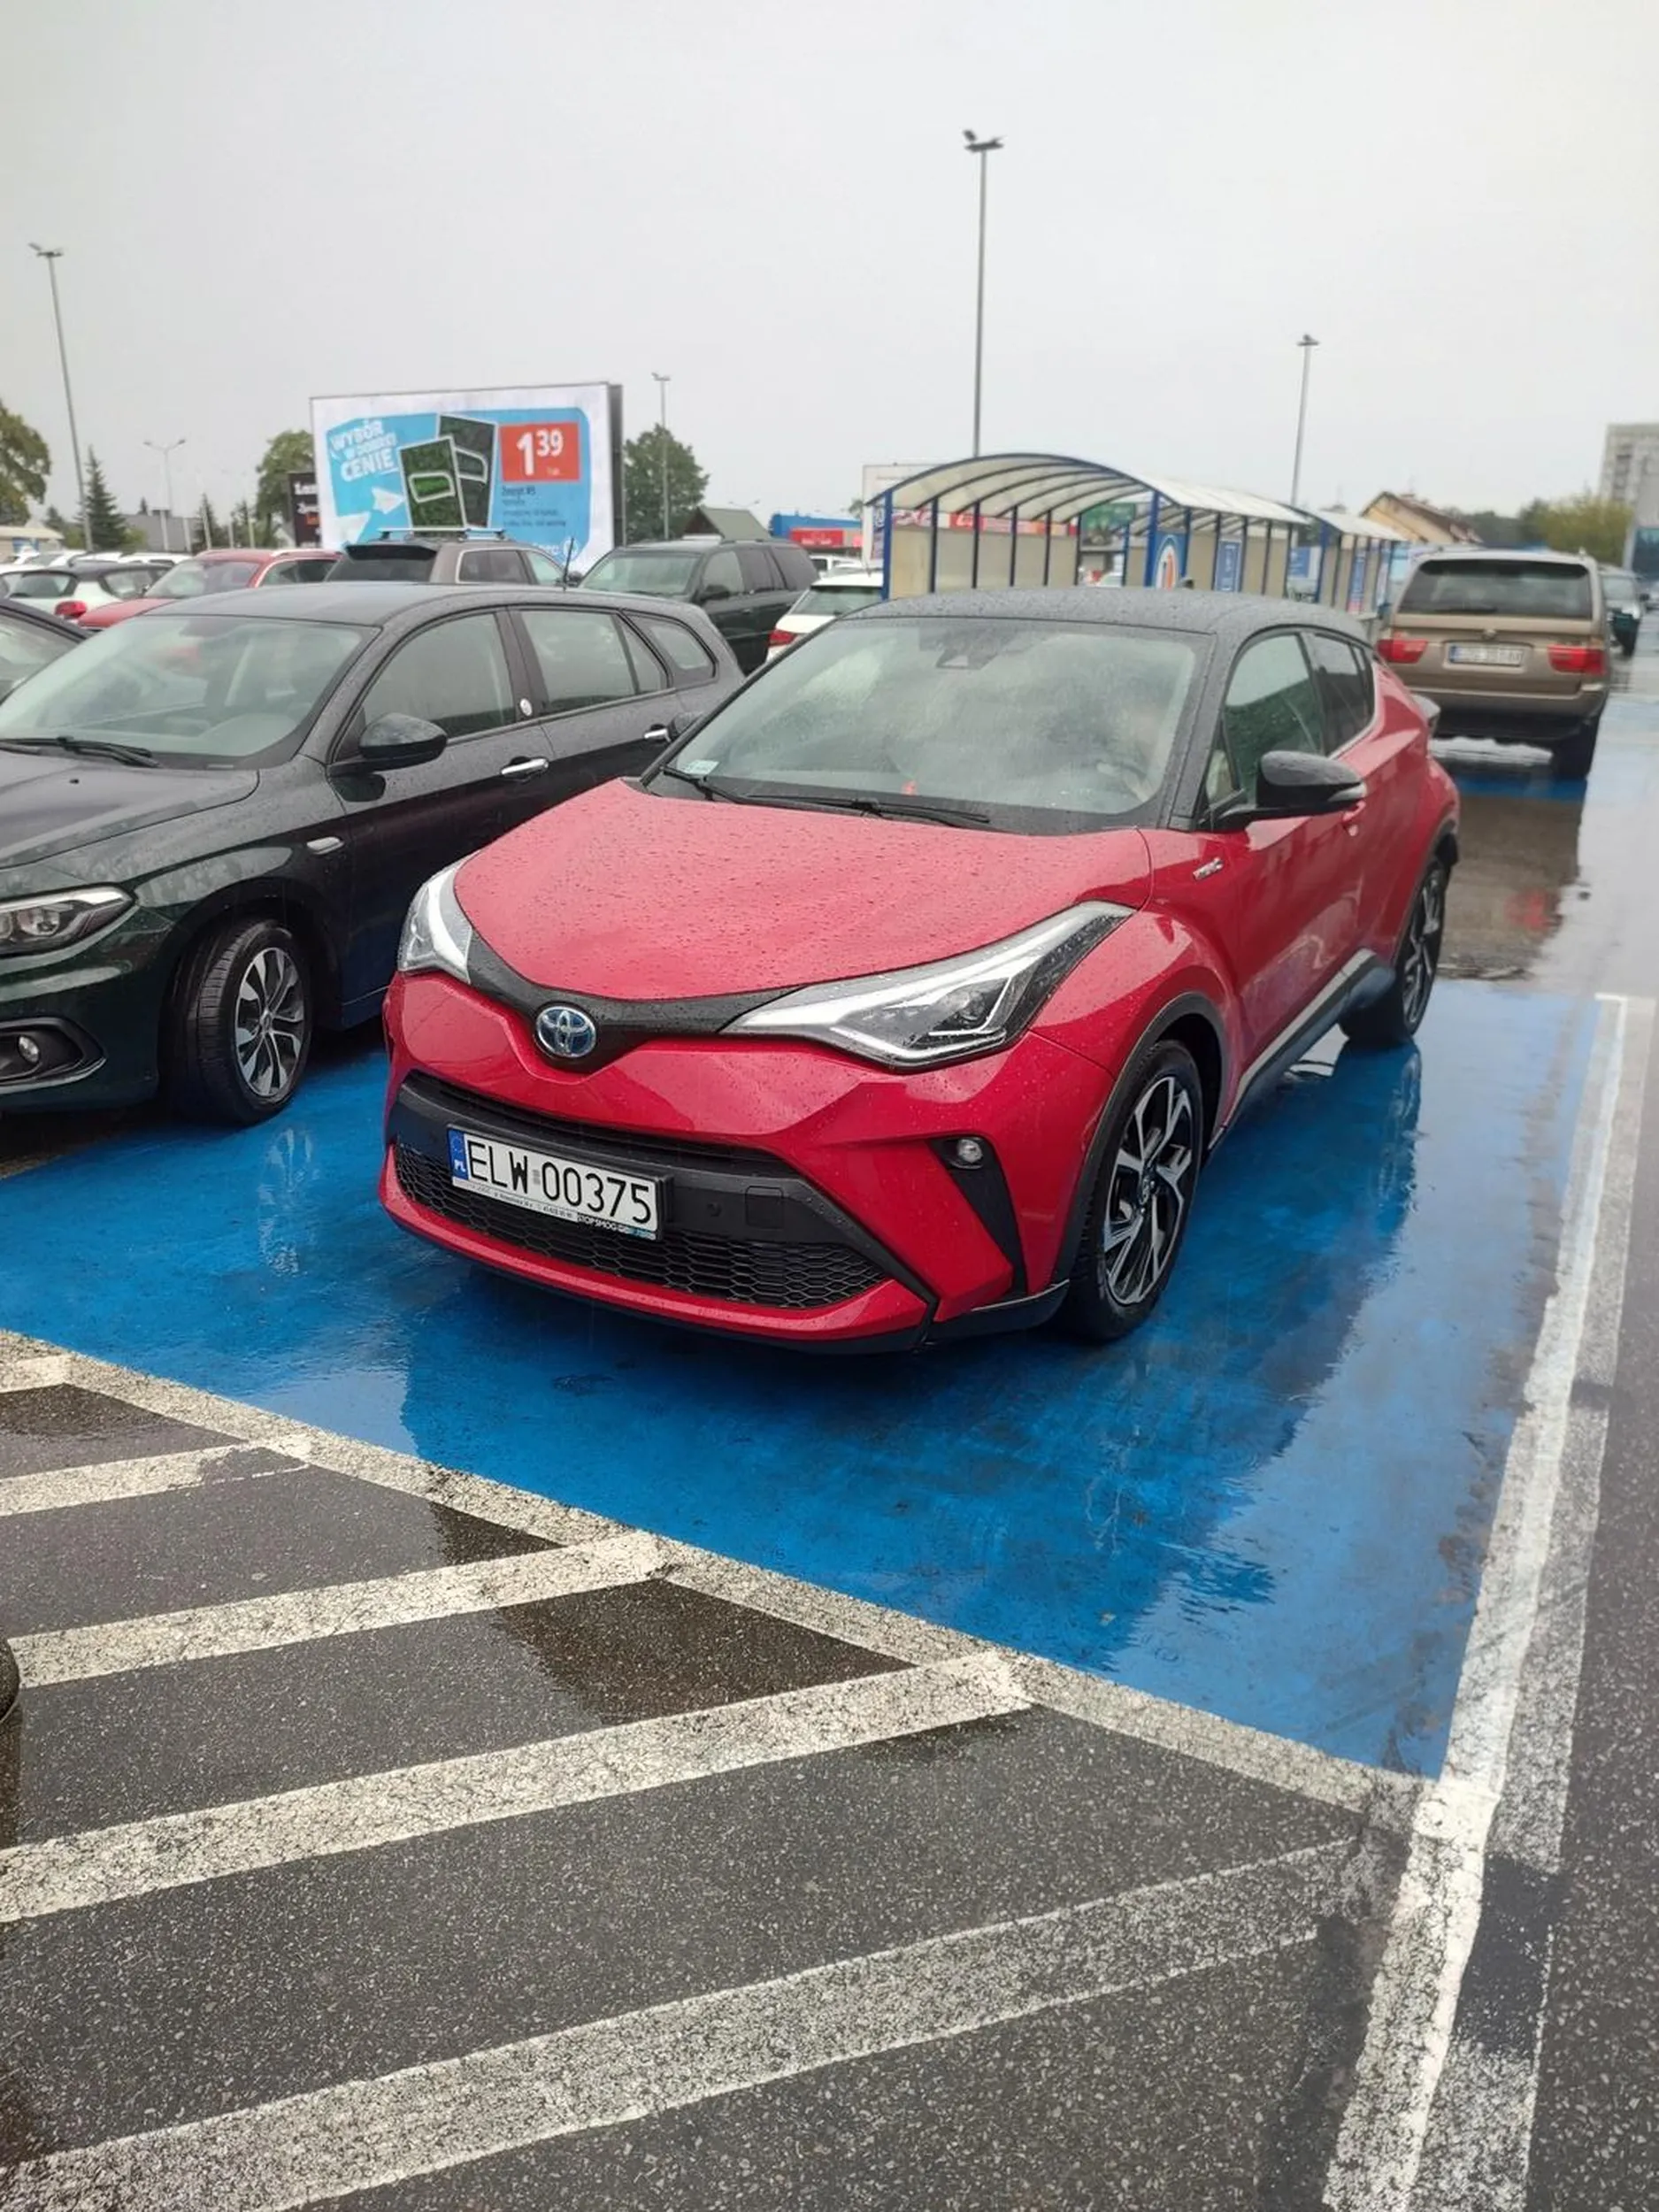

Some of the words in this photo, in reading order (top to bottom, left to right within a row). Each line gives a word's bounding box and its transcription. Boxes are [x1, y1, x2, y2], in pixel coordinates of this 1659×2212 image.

[341, 448, 396, 482] CENIE
[467, 1140, 528, 1194] ELW
[541, 1162, 651, 1224] 00375
